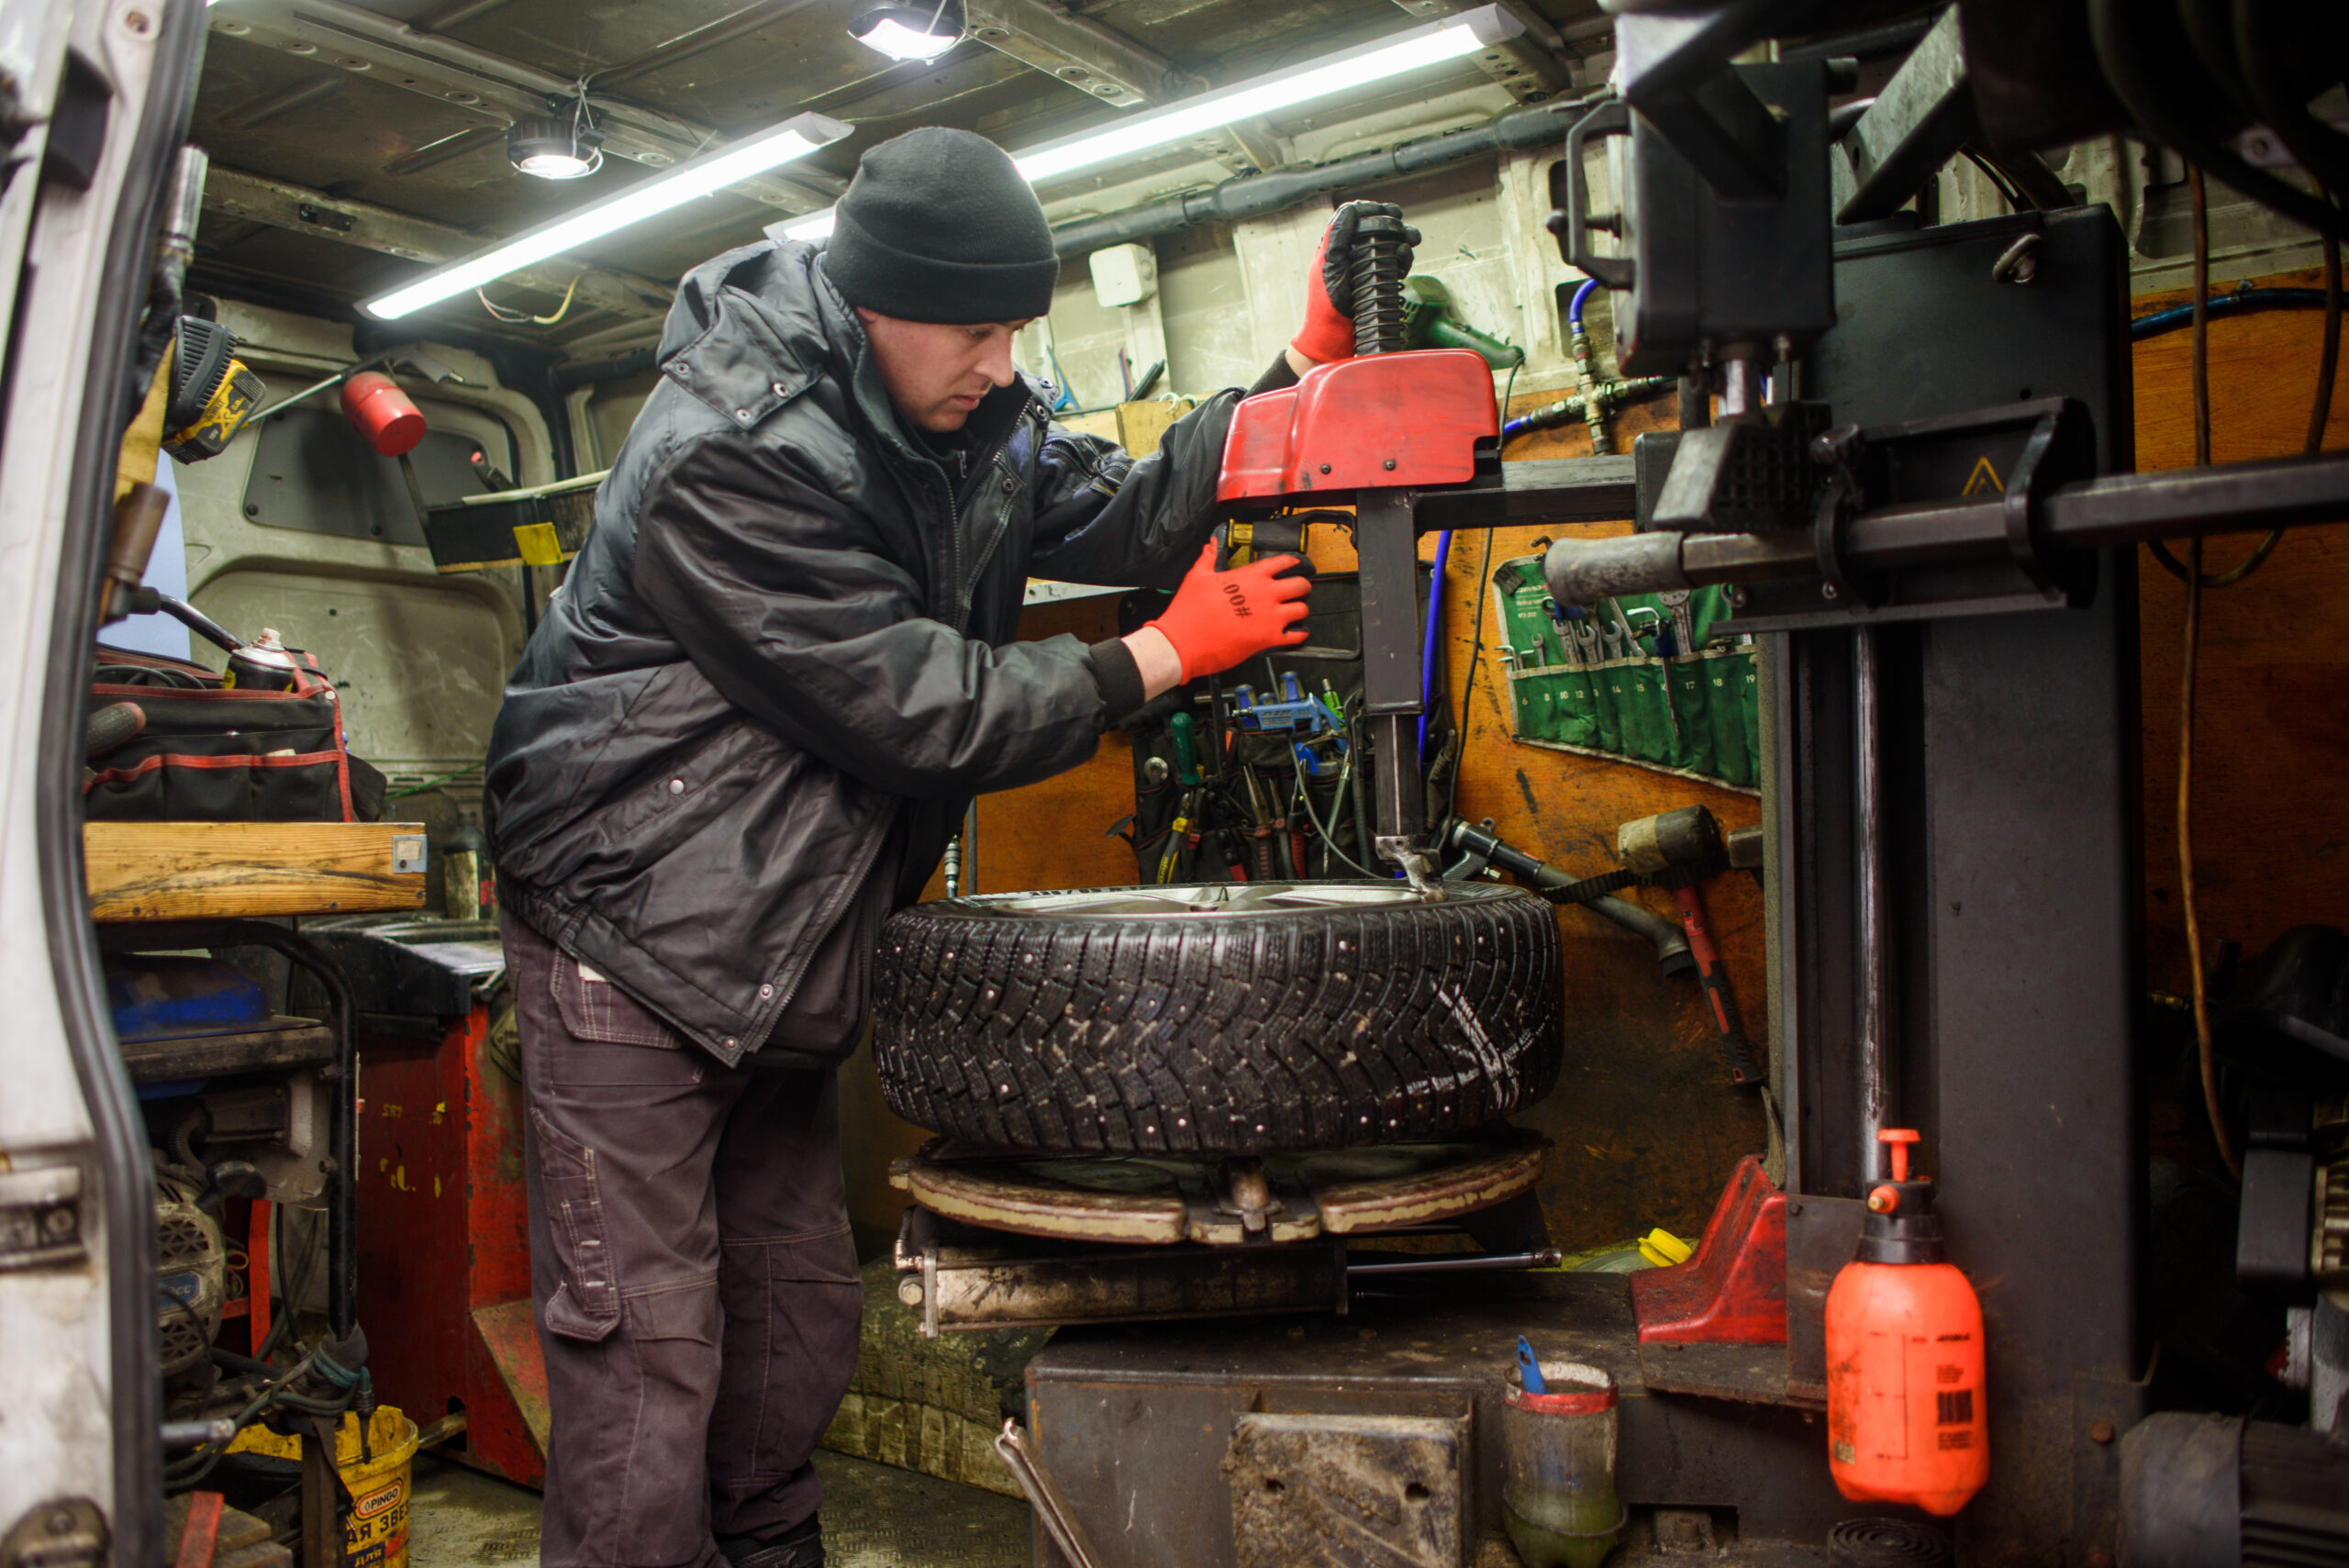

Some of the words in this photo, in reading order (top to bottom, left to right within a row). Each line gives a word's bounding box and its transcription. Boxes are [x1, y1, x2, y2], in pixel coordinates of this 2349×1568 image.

[1544, 694, 1551, 702] 8
[1560, 691, 1569, 699] 10
[1575, 690, 1585, 698] 12
[1612, 684, 1621, 694] 14
[1636, 684, 1645, 692] 15
[1686, 681, 1696, 690] 17
[1713, 678, 1723, 686] 18
[1746, 674, 1755, 684] 19
[371, 1487, 398, 1510] PINGO
